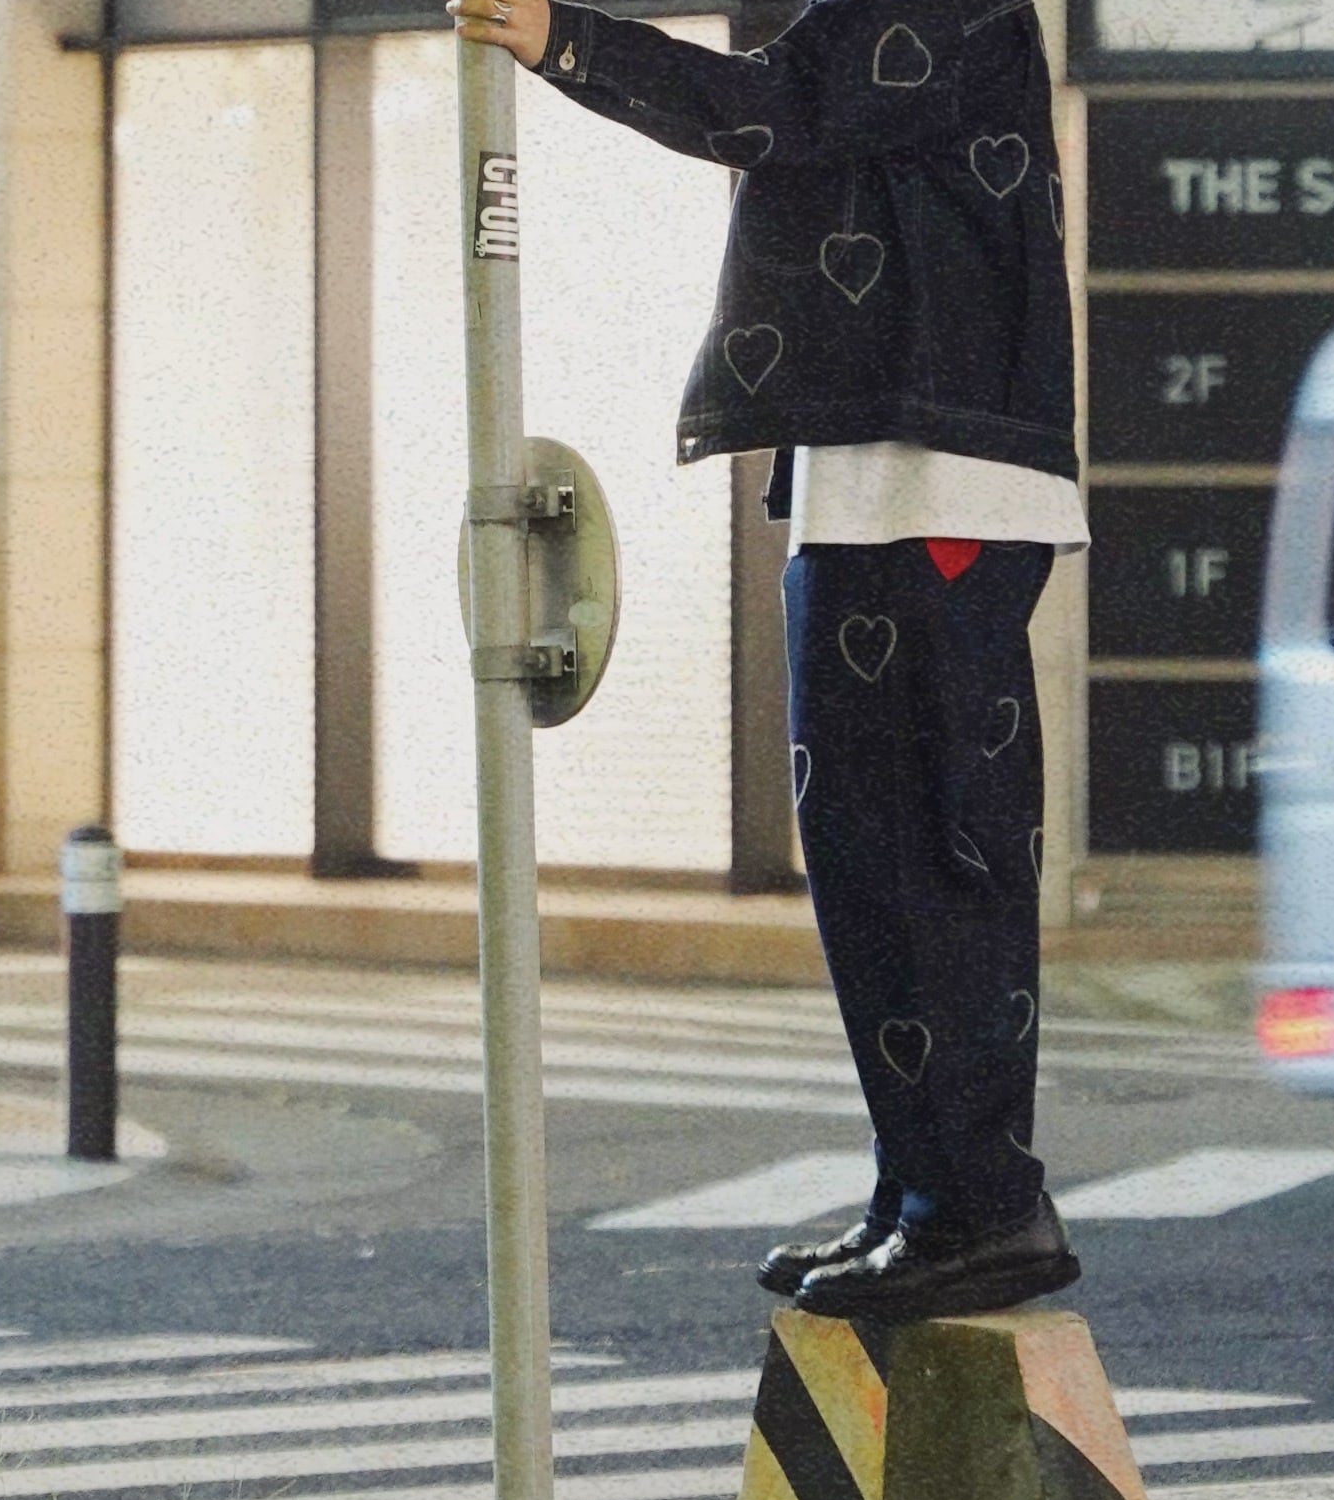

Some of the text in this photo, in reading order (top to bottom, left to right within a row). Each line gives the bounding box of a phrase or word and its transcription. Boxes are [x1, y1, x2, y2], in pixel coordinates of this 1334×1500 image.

[1161, 158, 1282, 215] THE
[1165, 354, 1228, 403] 2F
[1168, 548, 1229, 598] 1F
